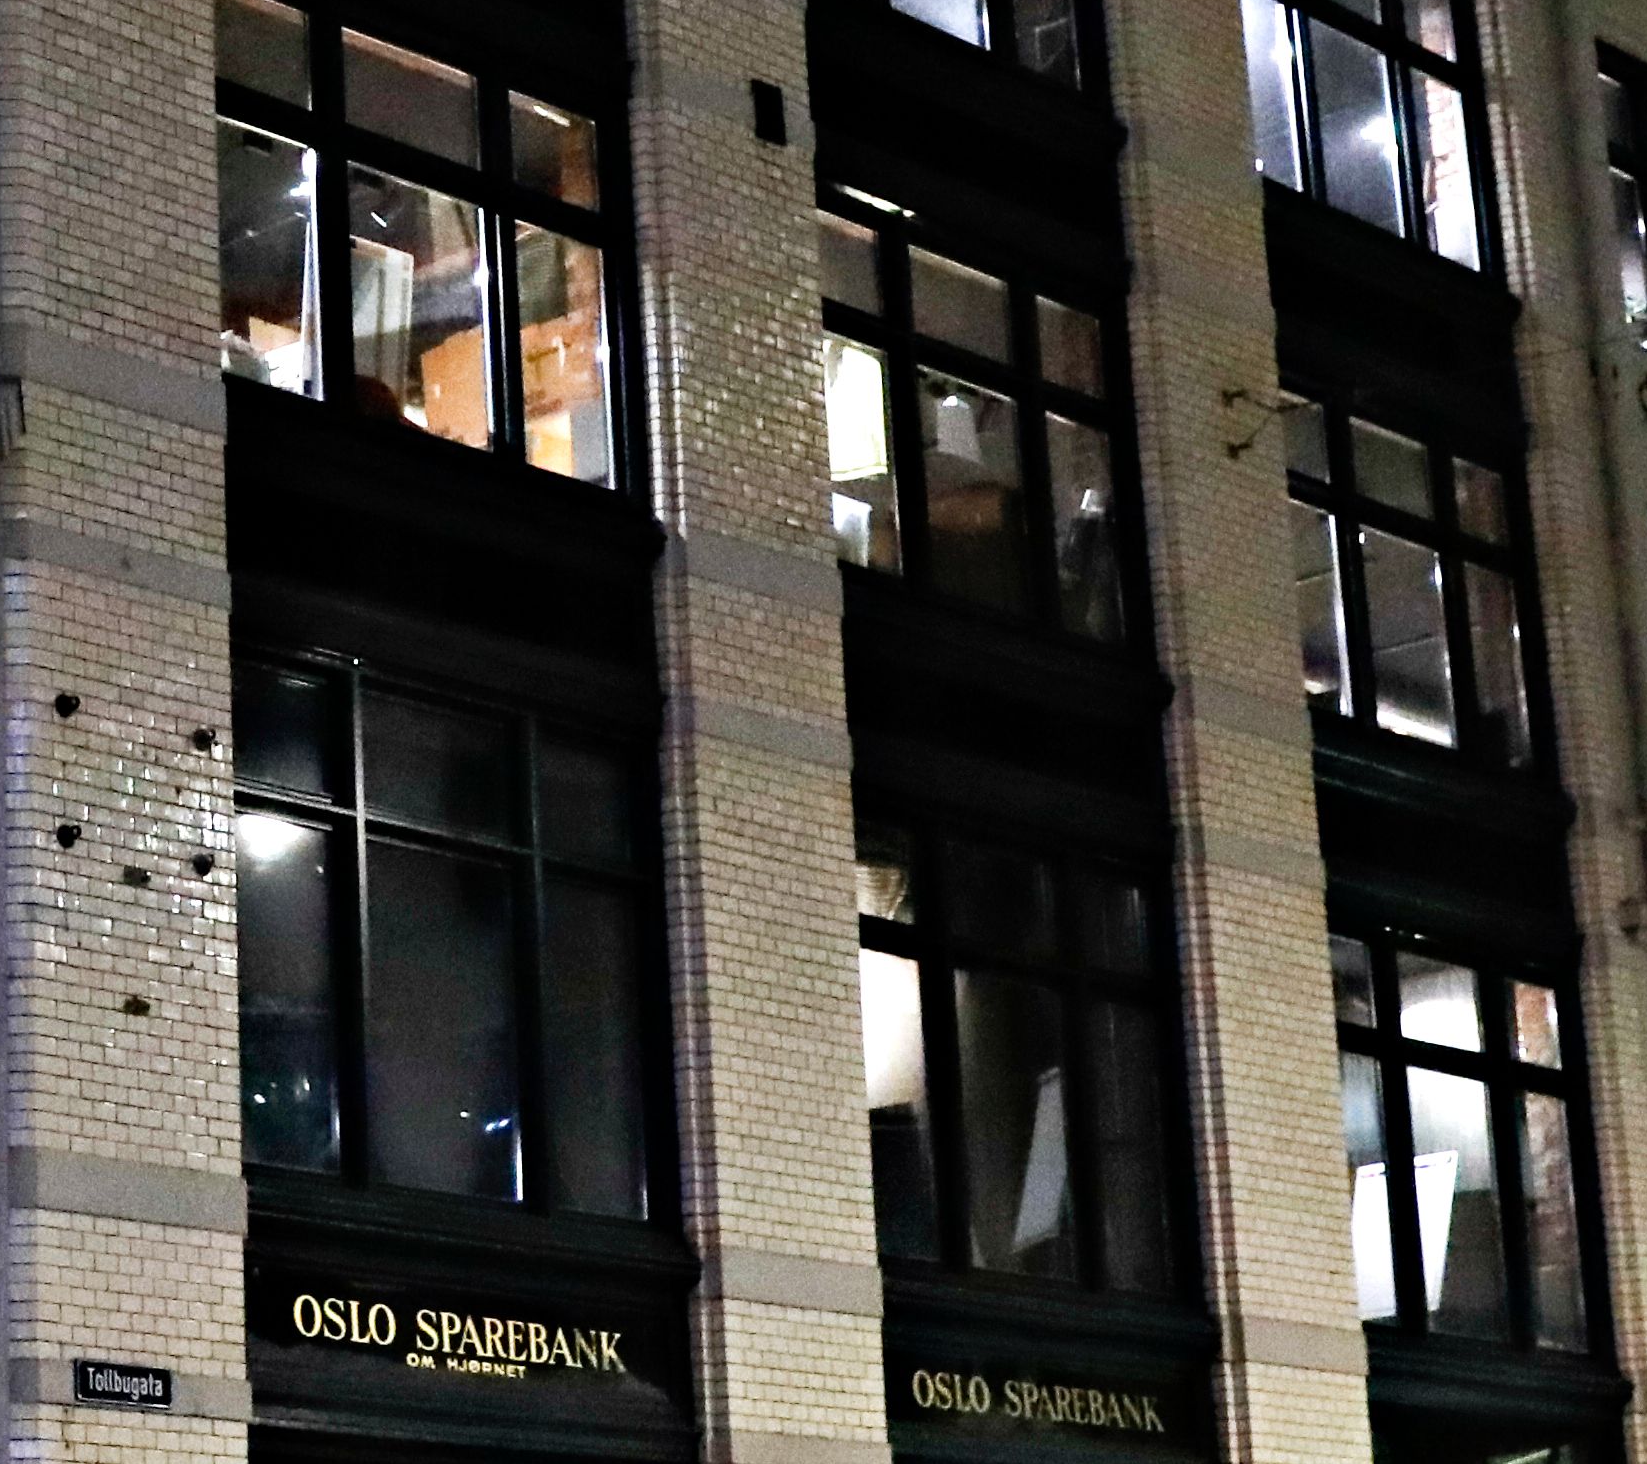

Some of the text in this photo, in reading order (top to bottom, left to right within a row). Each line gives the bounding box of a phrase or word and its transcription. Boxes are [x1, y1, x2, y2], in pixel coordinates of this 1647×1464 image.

[293, 1294, 627, 1374] OSLO SPAREBANK
[87, 1367, 163, 1401] Tollbugata
[446, 1357, 527, 1379] HJØRNET
[912, 1368, 1165, 1433] OSLO SPAREBANK
